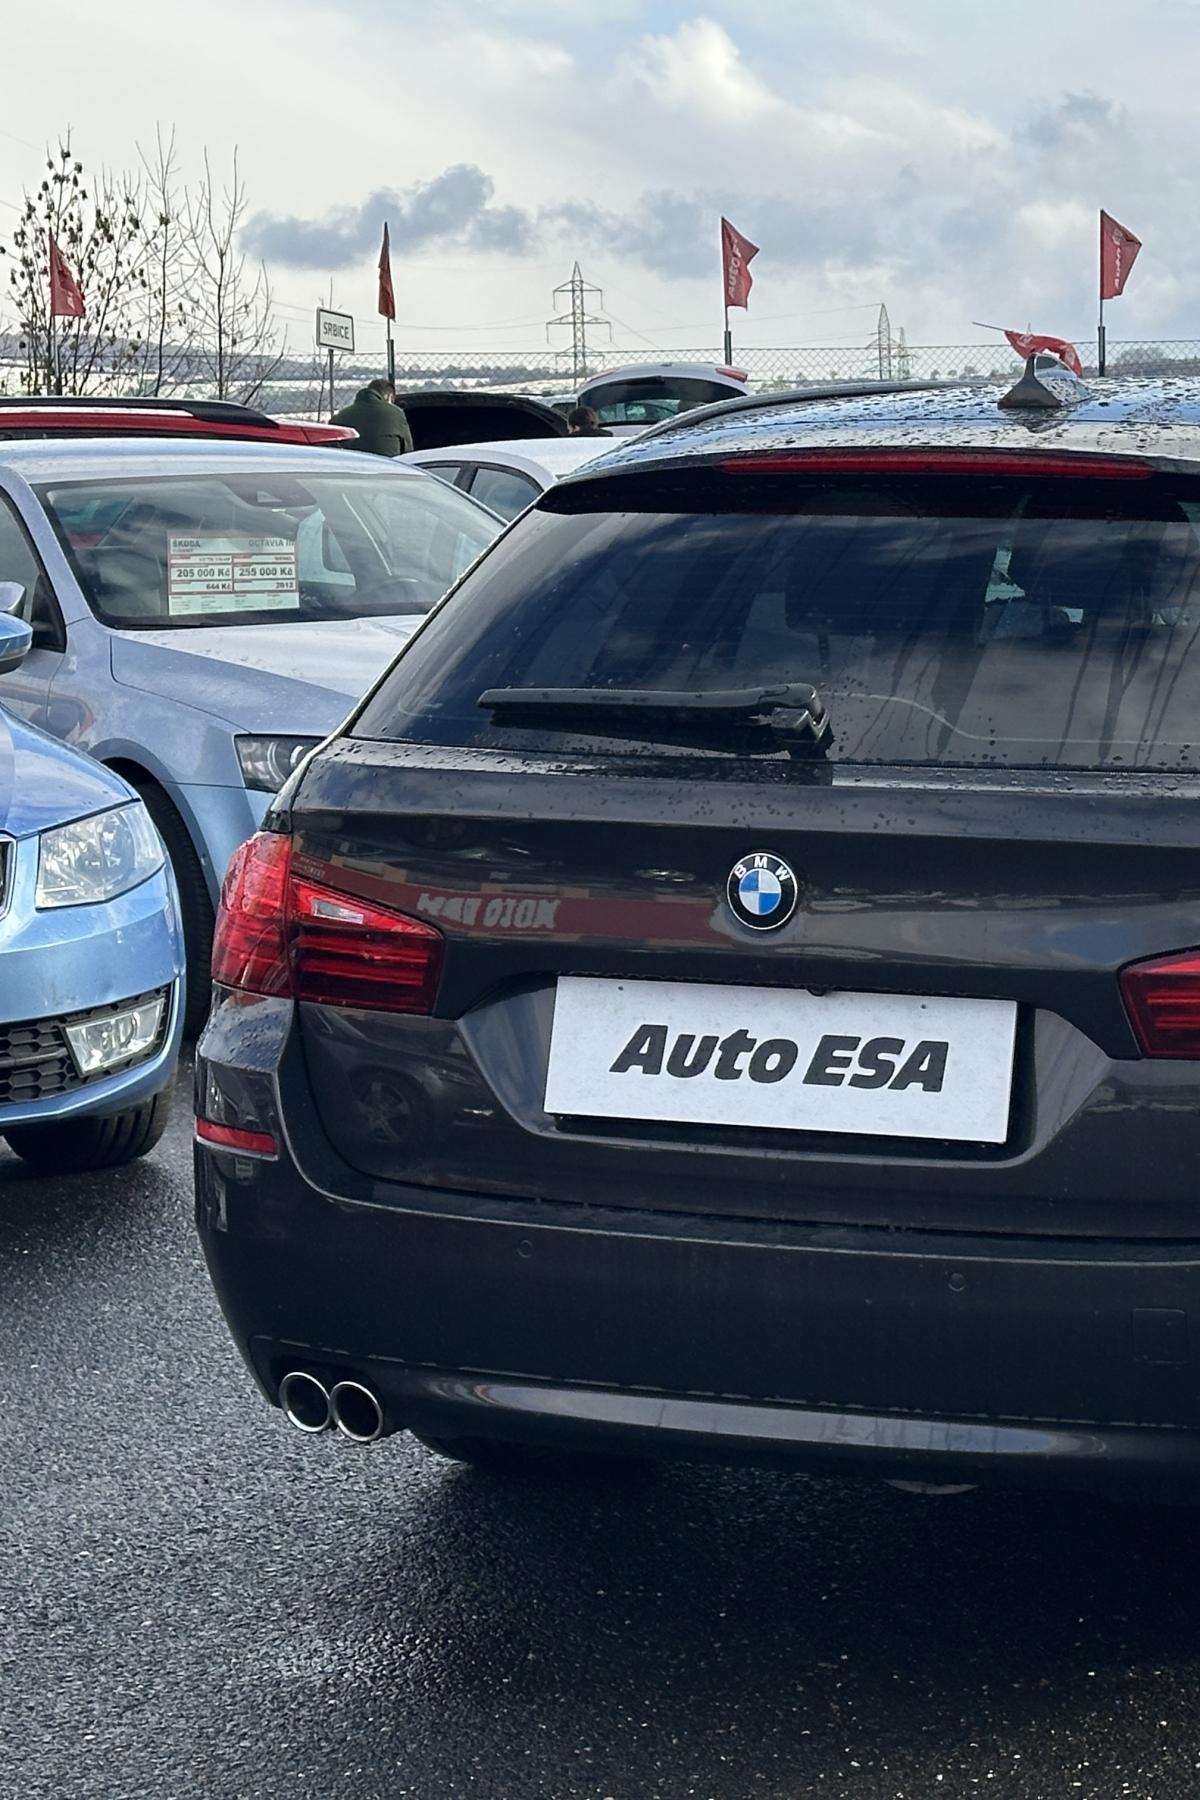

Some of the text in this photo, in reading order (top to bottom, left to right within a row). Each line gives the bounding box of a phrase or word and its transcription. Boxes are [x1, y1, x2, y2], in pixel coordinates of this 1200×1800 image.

[323, 321, 350, 340] SRBICE
[248, 539, 284, 548] OCTAVIA
[177, 568, 231, 578] 205 000 Kč
[239, 567, 293, 577] 255 000 Kč
[733, 855, 791, 881] BMW
[609, 1023, 950, 1093] Auto ESA
